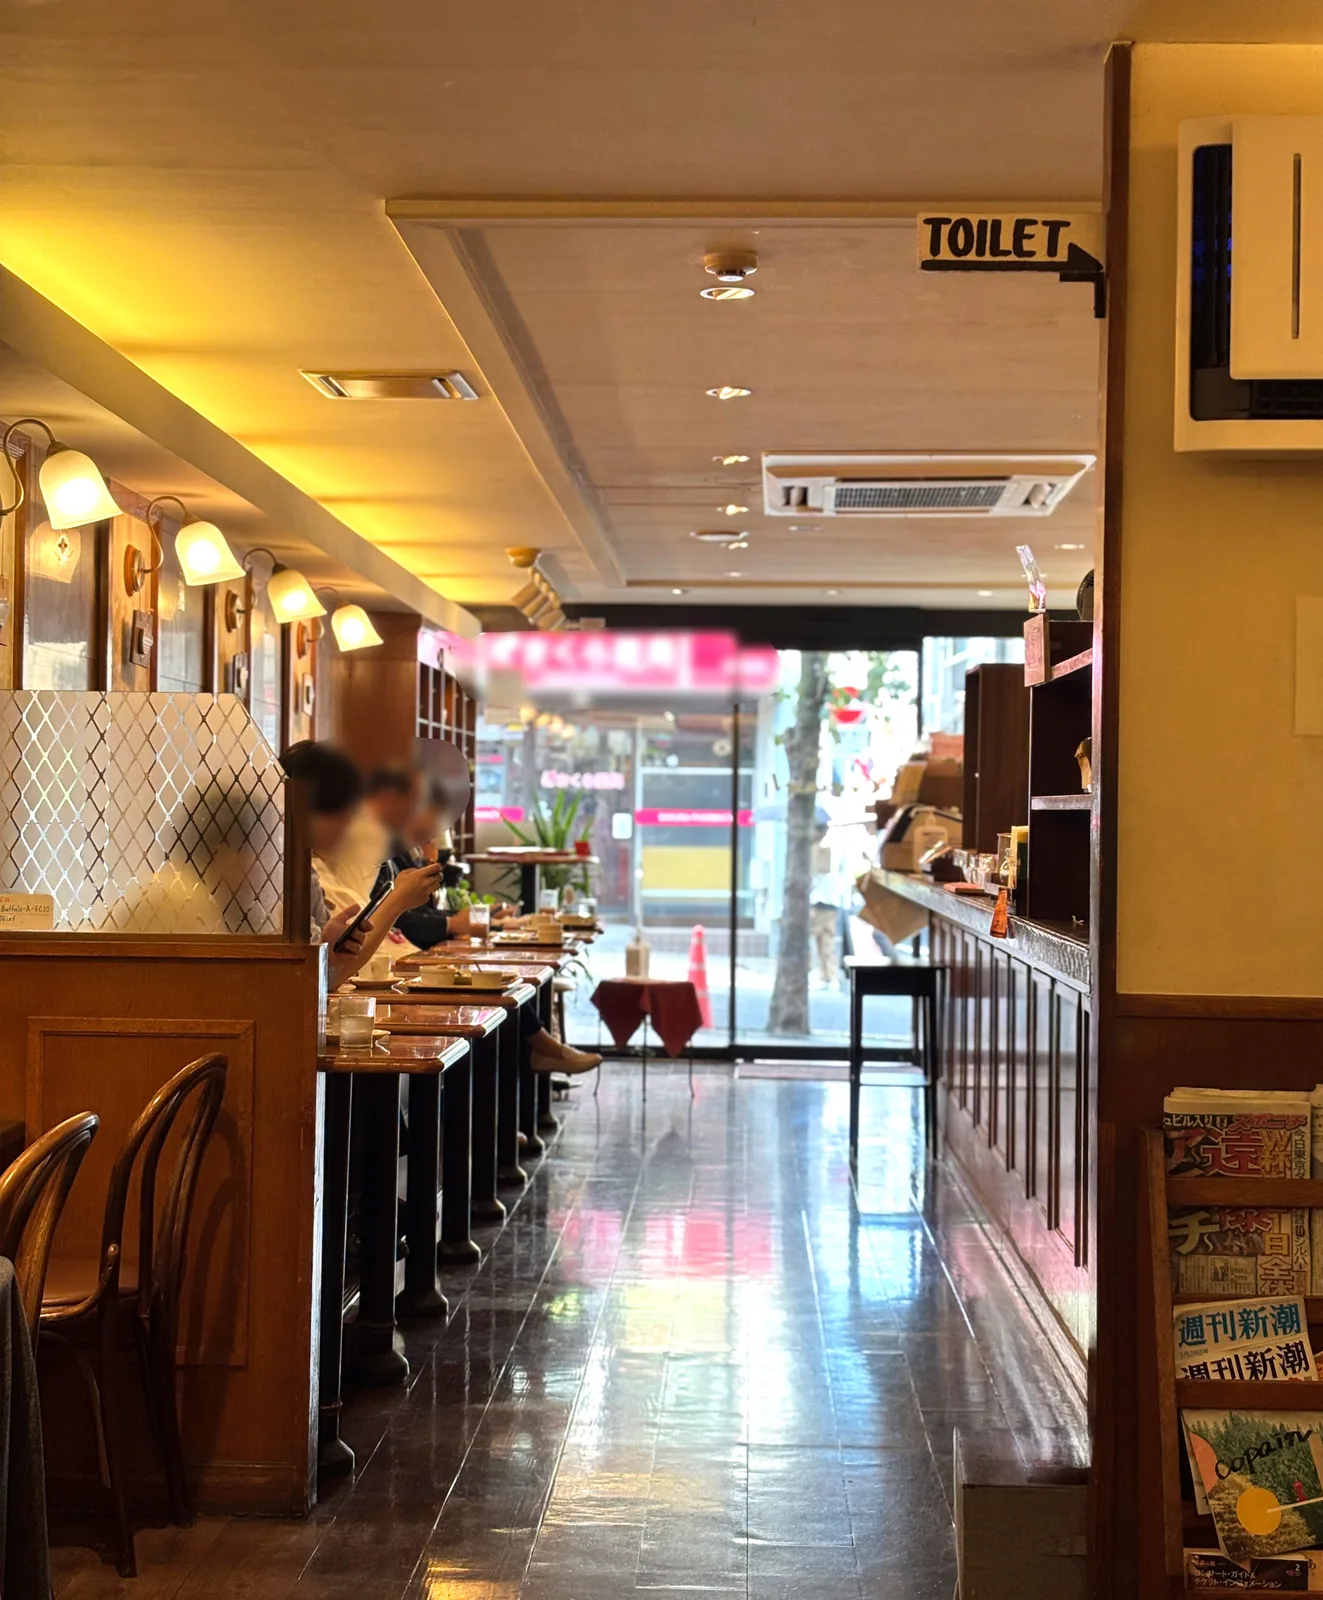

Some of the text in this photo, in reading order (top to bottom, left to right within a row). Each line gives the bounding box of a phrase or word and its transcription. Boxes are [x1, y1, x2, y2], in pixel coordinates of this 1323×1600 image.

[923, 217, 1071, 258] TOILET
[1228, 1113, 1308, 1131] スポニチ
[1178, 1303, 1302, 1348] 週刊新潮
[1181, 1340, 1310, 1380] 週刊新潮
